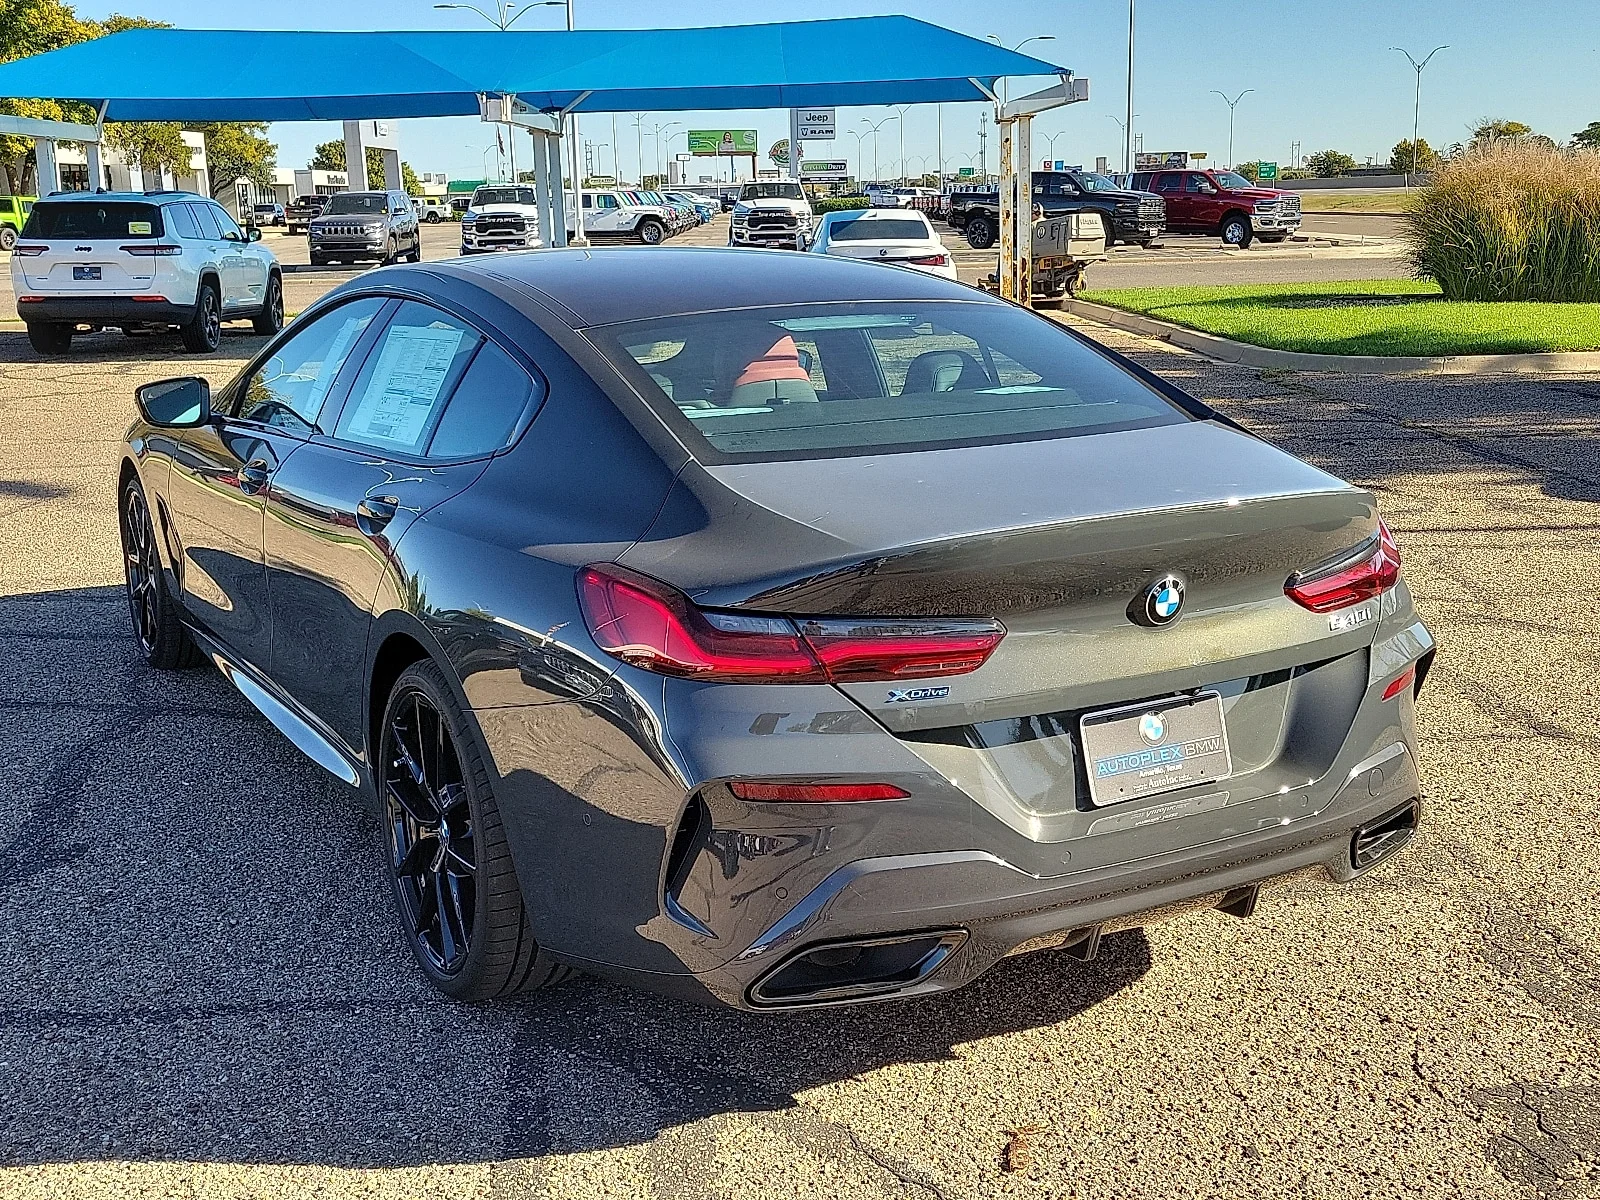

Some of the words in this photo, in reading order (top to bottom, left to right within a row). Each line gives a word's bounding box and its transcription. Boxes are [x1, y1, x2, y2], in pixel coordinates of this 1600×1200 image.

[805, 112, 829, 123] Jeep
[74, 245, 92, 253] Jeep
[1153, 579, 1184, 597] BMW
[1097, 746, 1182, 775] AUTOPLEX
[1184, 738, 1220, 756] BMW
